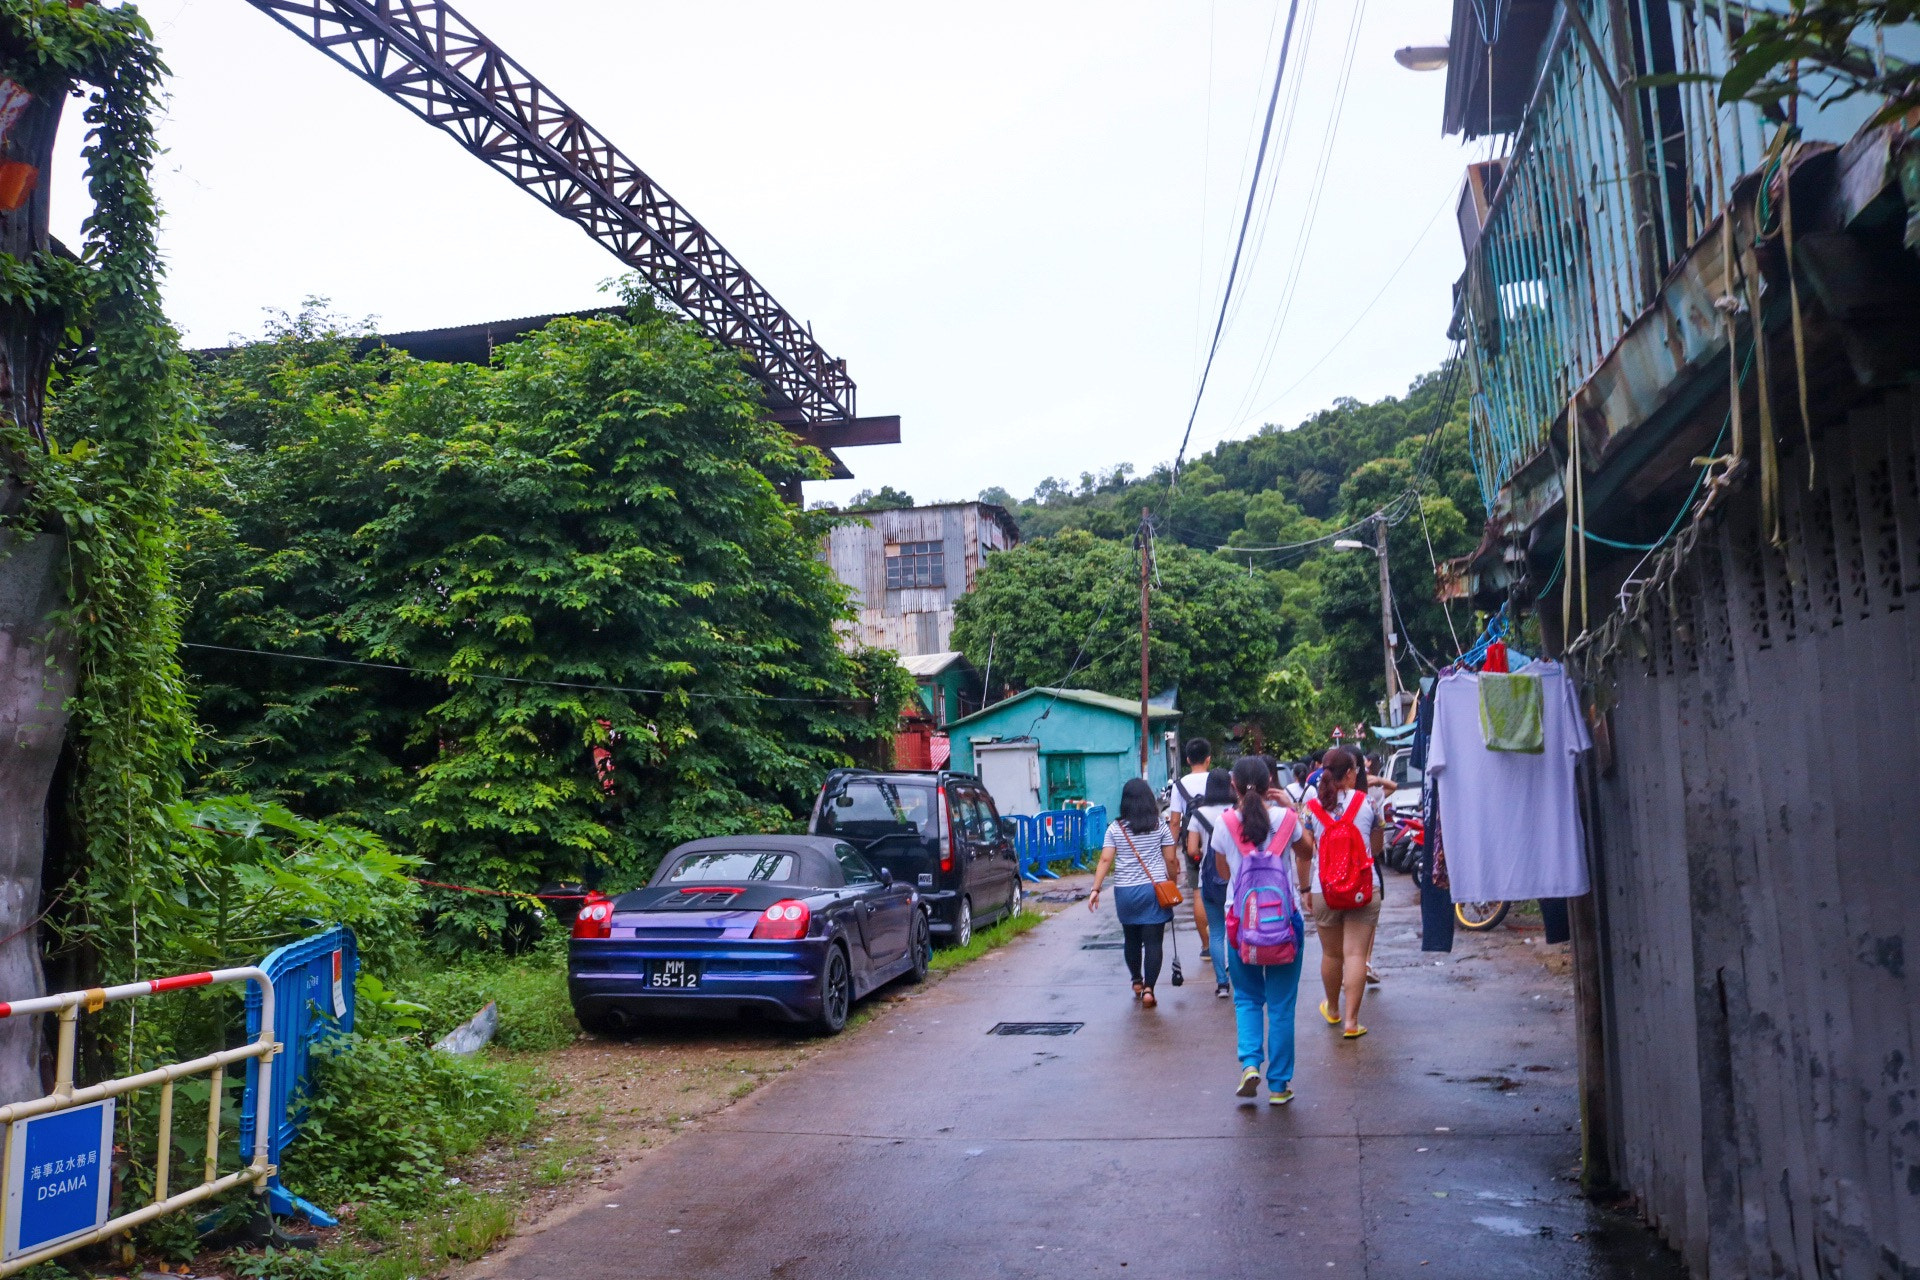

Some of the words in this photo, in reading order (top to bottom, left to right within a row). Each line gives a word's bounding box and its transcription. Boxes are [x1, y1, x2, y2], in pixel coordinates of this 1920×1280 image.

[665, 961, 685, 974] MM
[652, 973, 697, 987] 55-12
[30, 1150, 97, 1181] 海事及水務局
[37, 1174, 87, 1201] DSAMA
